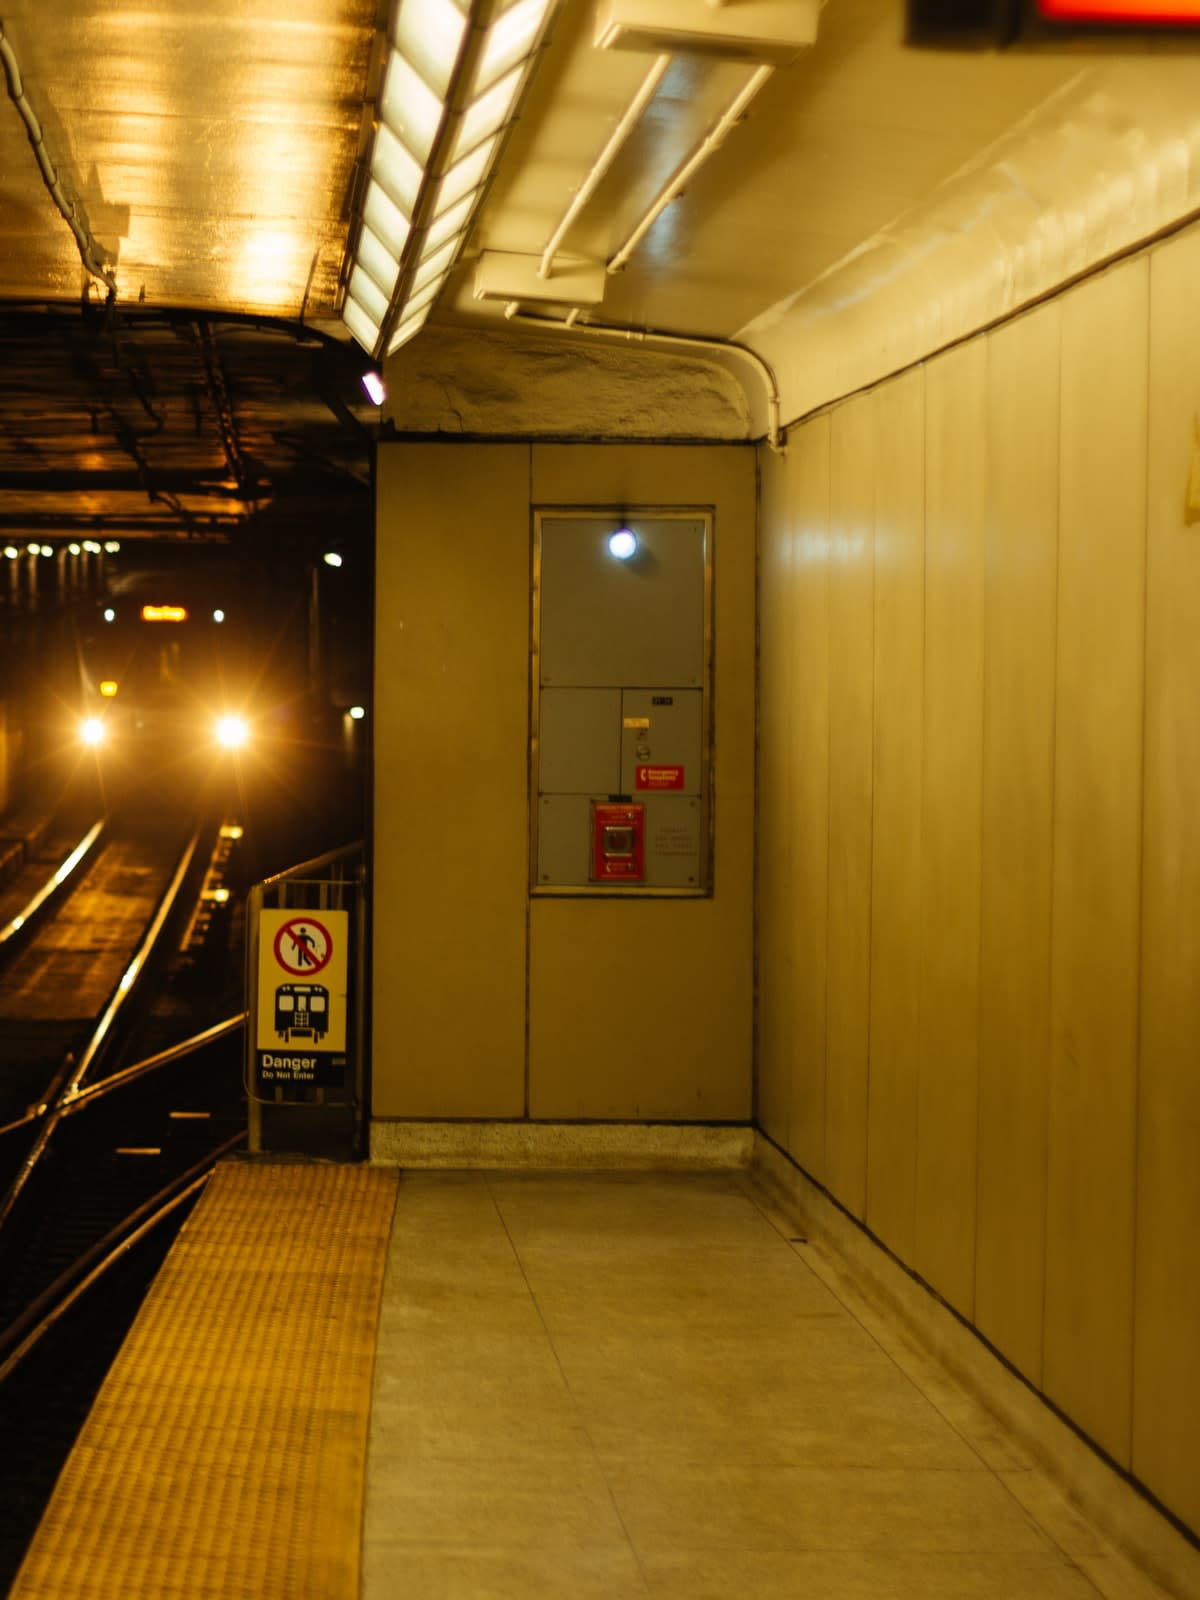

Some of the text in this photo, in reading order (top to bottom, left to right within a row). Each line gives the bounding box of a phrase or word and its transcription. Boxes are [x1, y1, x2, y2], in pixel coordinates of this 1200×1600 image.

[262, 1054, 316, 1070] Danger
[262, 1071, 314, 1080] Do Not Enter
